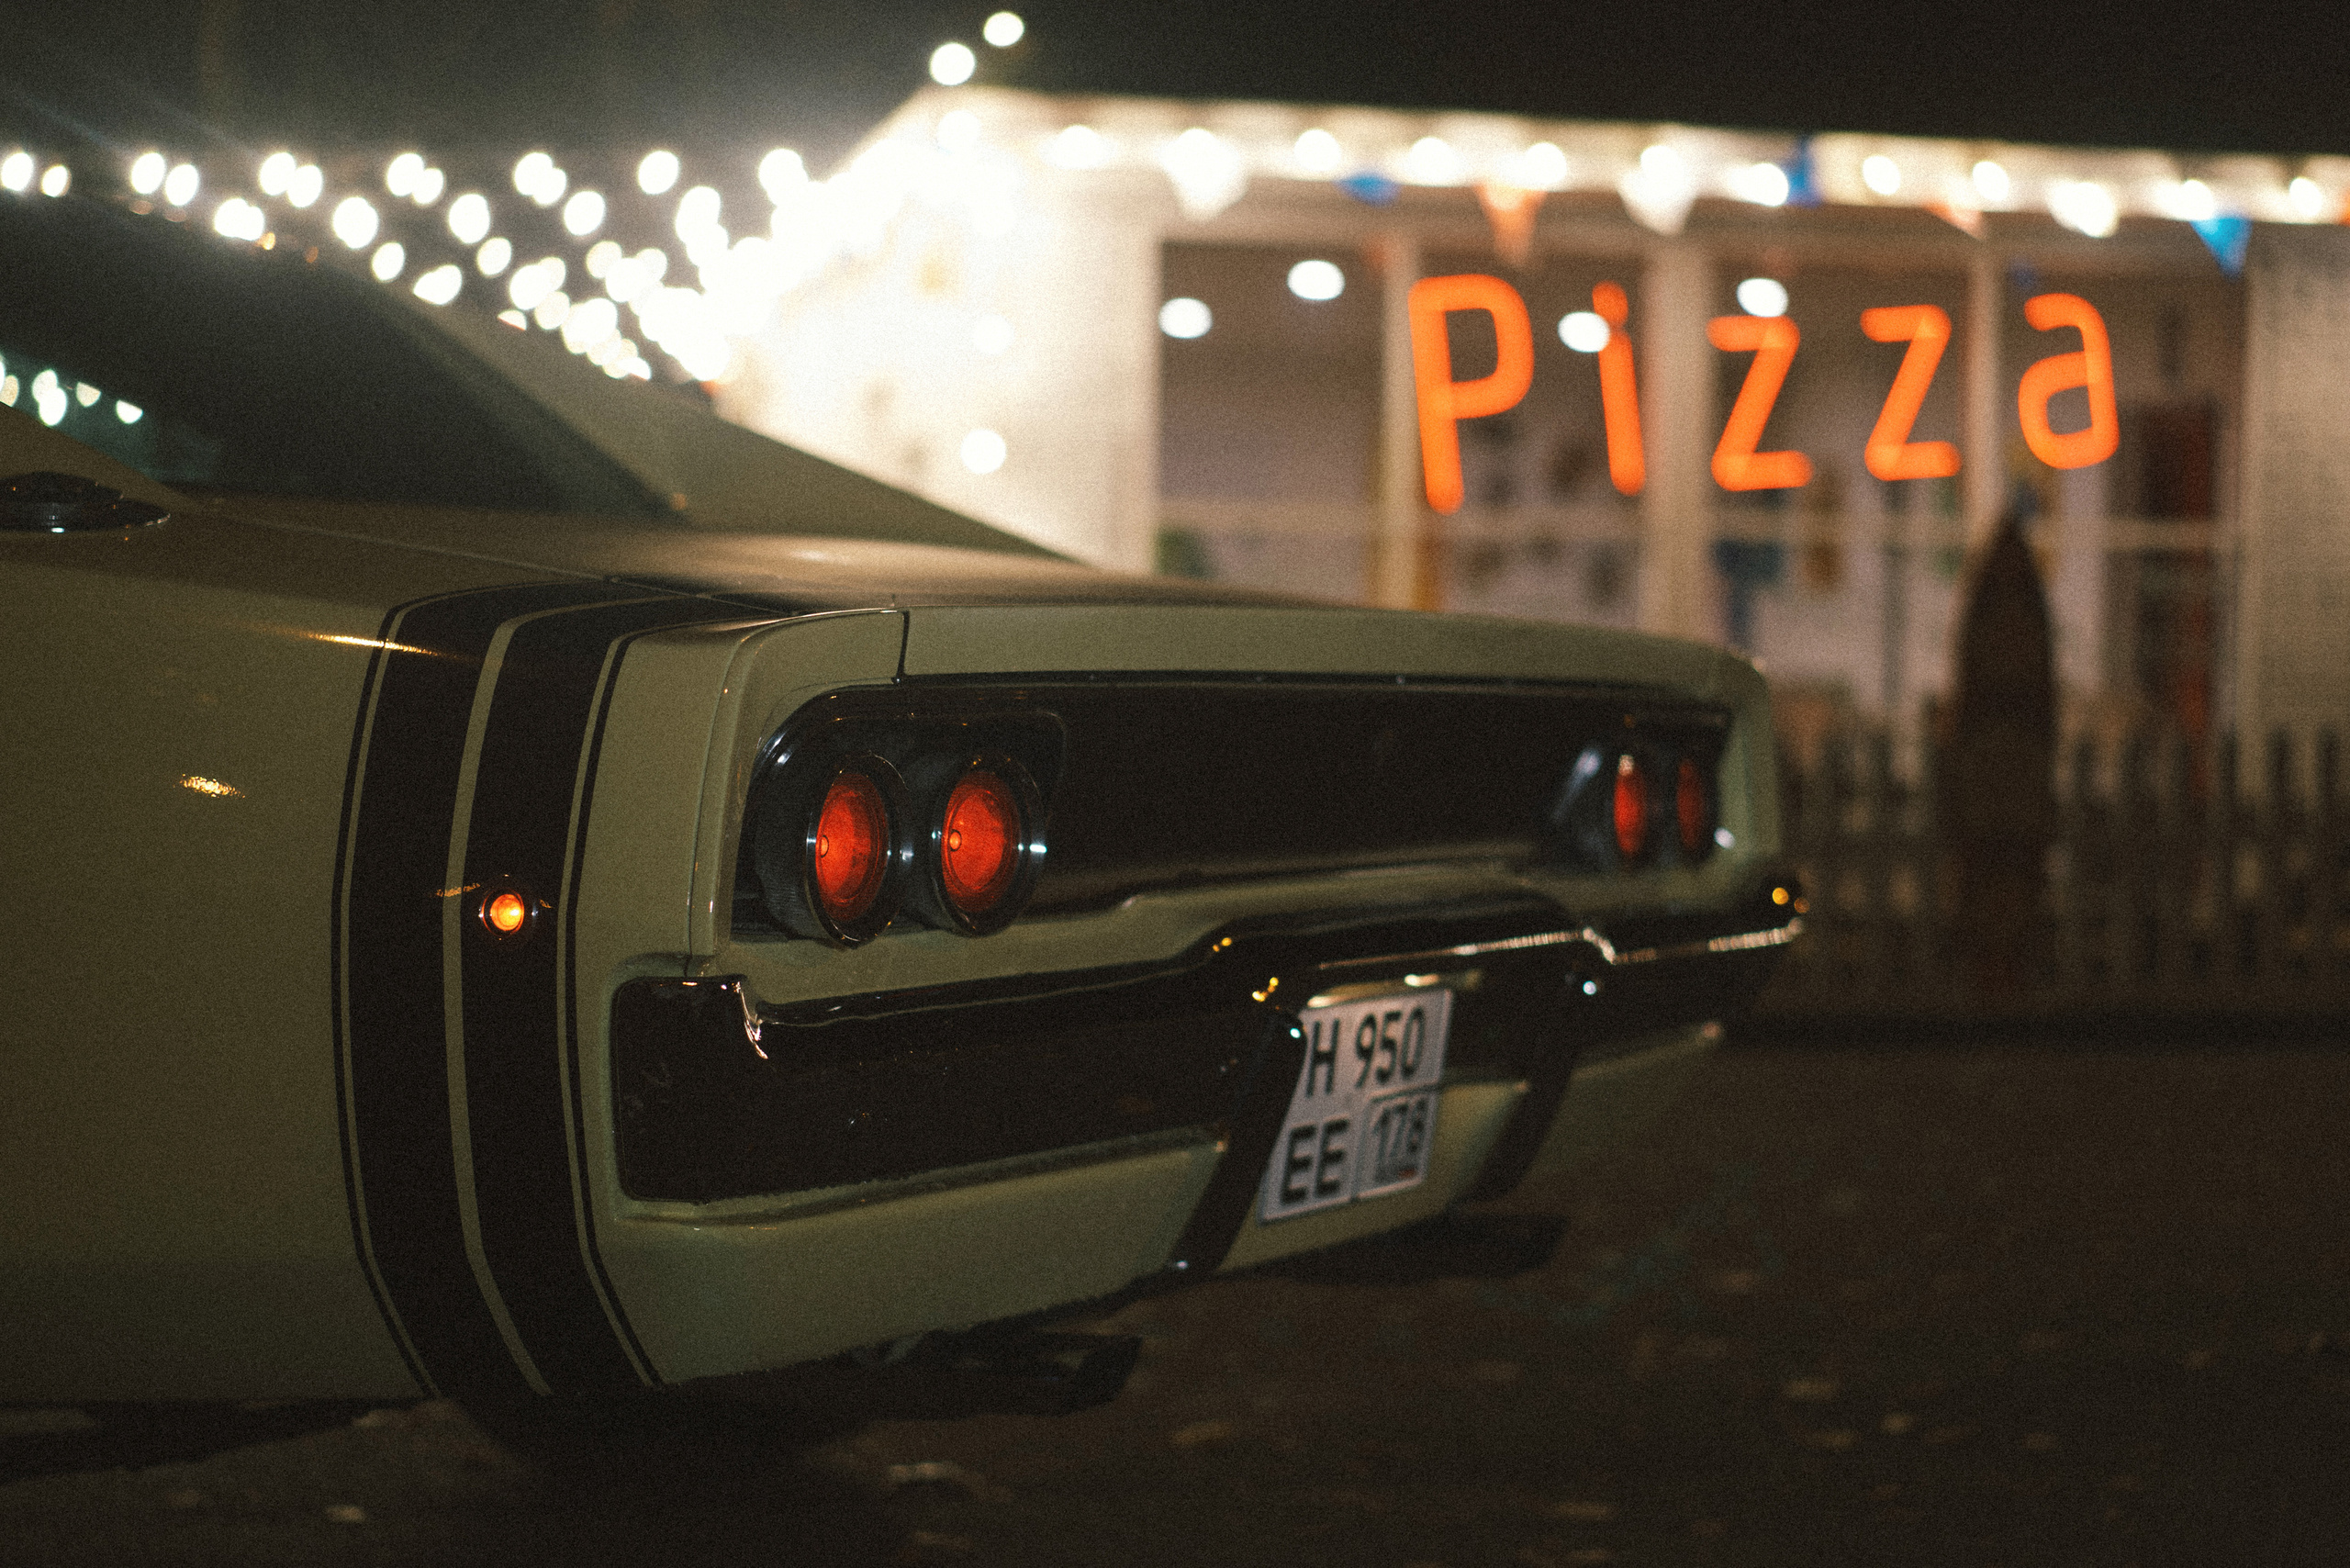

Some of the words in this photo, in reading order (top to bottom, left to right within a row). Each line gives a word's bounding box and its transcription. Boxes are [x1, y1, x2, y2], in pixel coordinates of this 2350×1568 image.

[1408, 273, 2121, 515] Pizza
[1305, 1018, 1341, 1100] H
[1354, 1007, 1425, 1091] 950
[1279, 1117, 1349, 1206] EE
